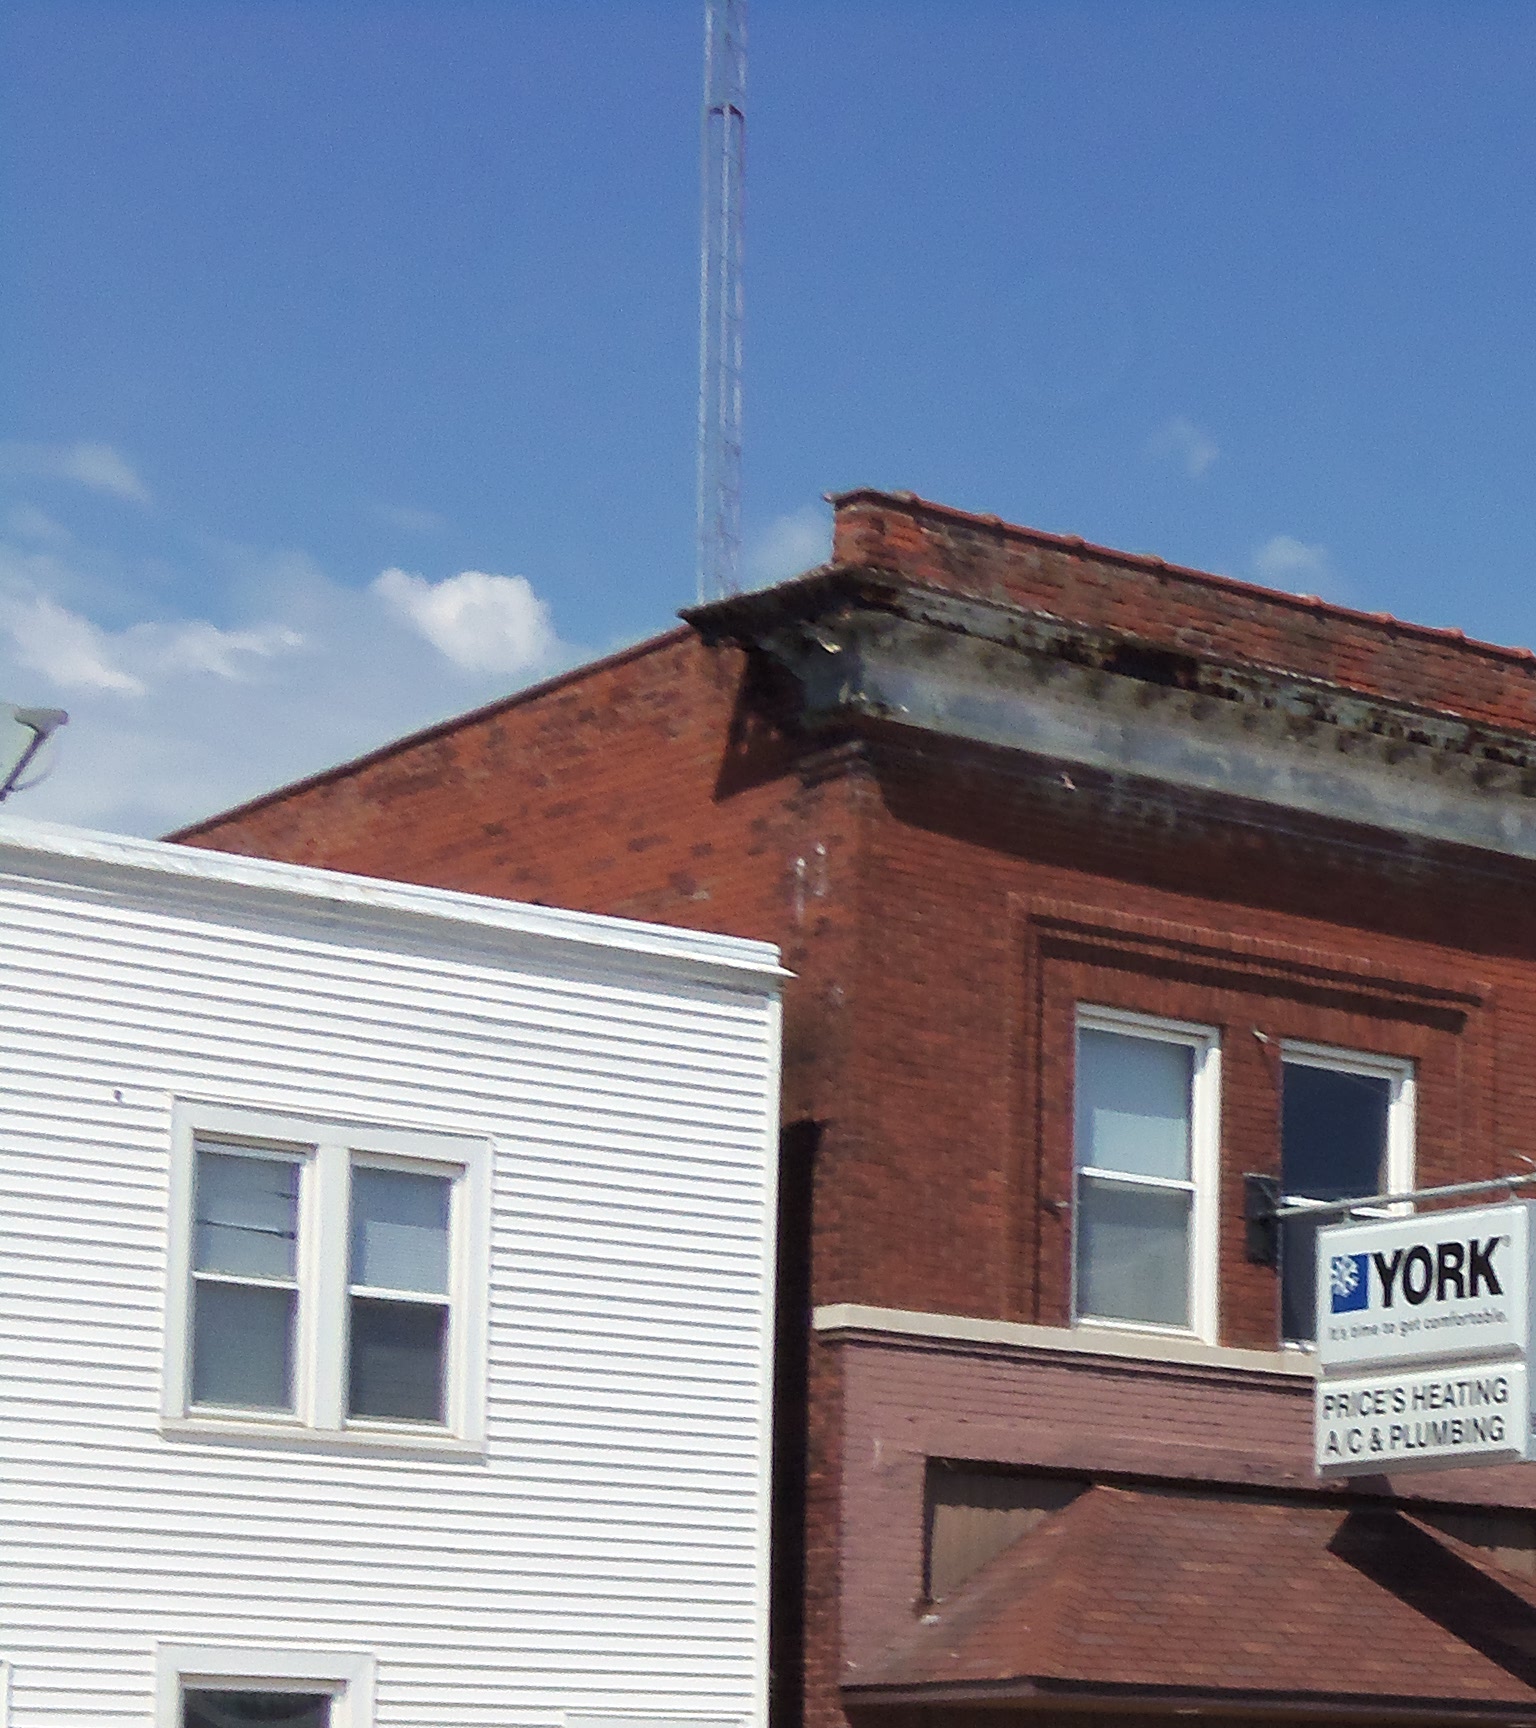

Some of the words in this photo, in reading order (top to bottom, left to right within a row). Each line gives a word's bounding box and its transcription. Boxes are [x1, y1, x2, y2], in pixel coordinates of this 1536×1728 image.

[1372, 1236, 1503, 1308] YORK
[1322, 1387, 1405, 1420] PRICE'S
[1413, 1377, 1508, 1410] HEATING
[1370, 1427, 1384, 1452] &
[1389, 1415, 1504, 1449] PLUMBING
